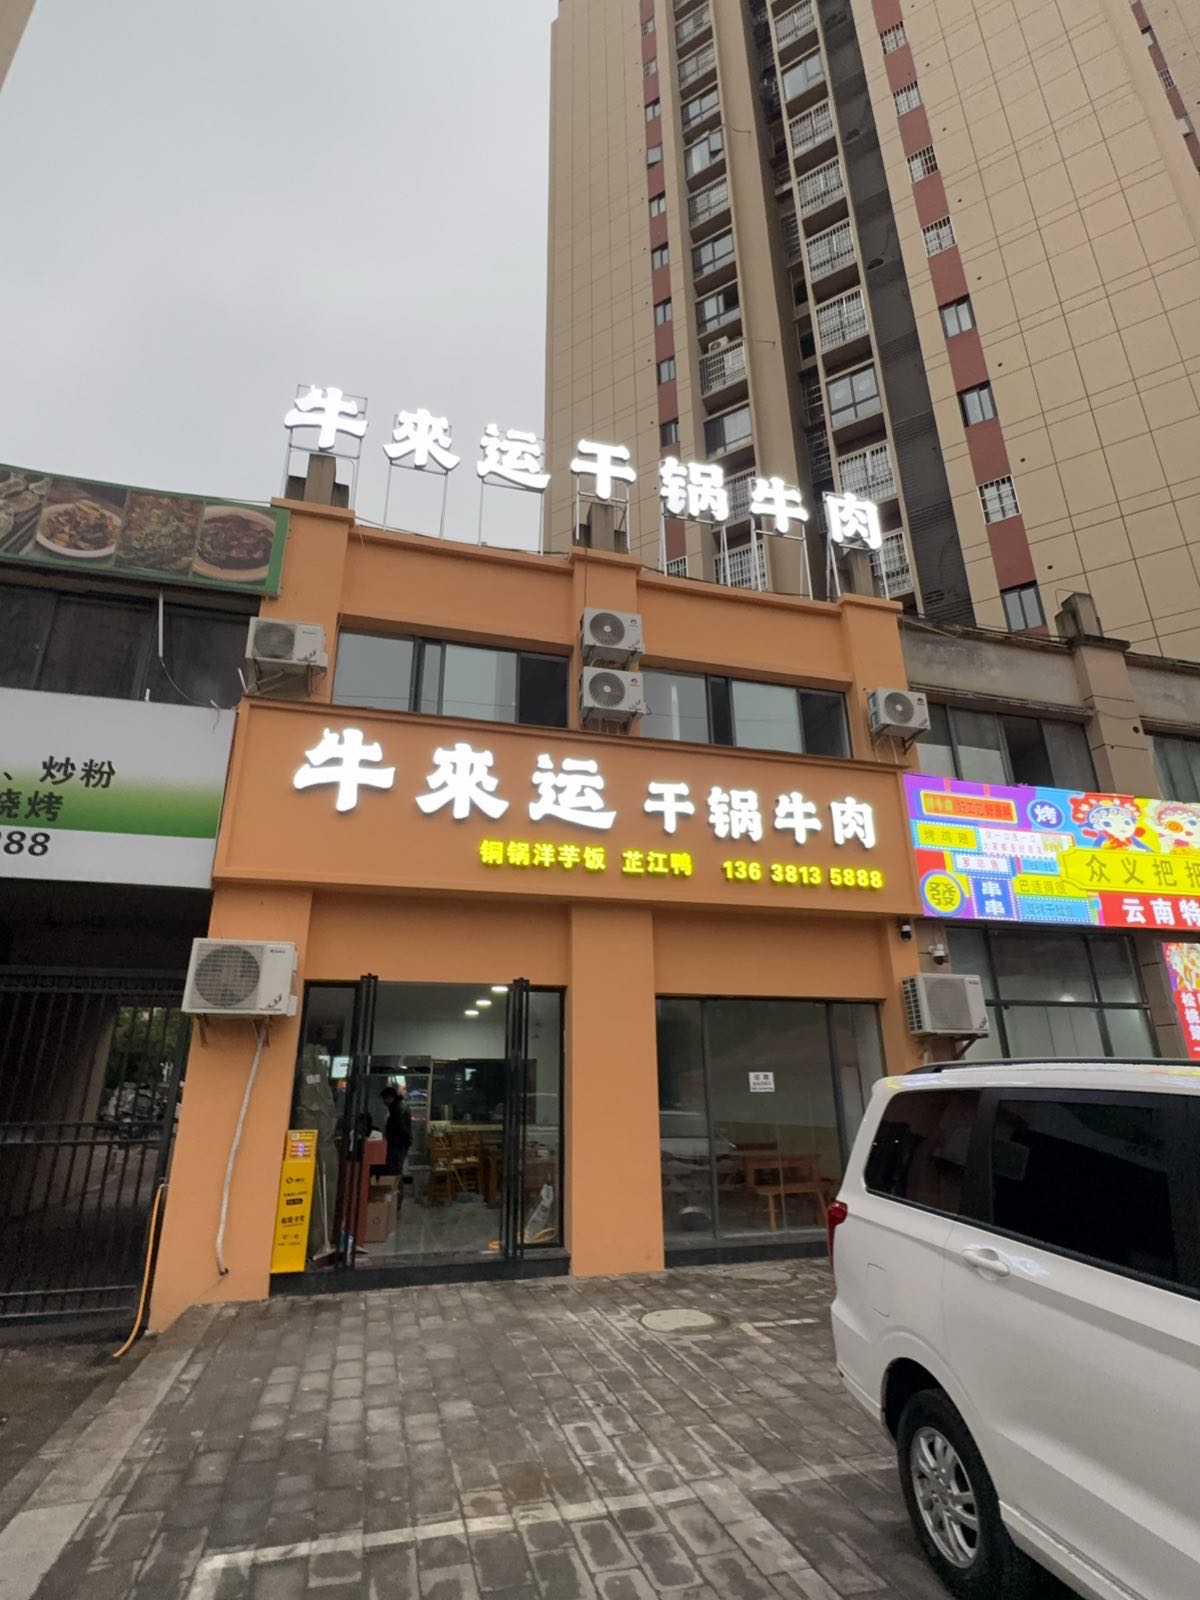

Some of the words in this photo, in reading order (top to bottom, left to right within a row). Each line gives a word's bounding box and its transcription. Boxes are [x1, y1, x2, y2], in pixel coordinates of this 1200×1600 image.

[644, 782, 876, 849] 干锅牛肉
[1033, 805, 1059, 825] 烤
[479, 839, 606, 870] 铜锅洋芋饭
[622, 850, 693, 876] 芷江鸭
[723, 860, 762, 881] 136
[770, 863, 822, 885] 3813
[830, 867, 884, 889] 5888
